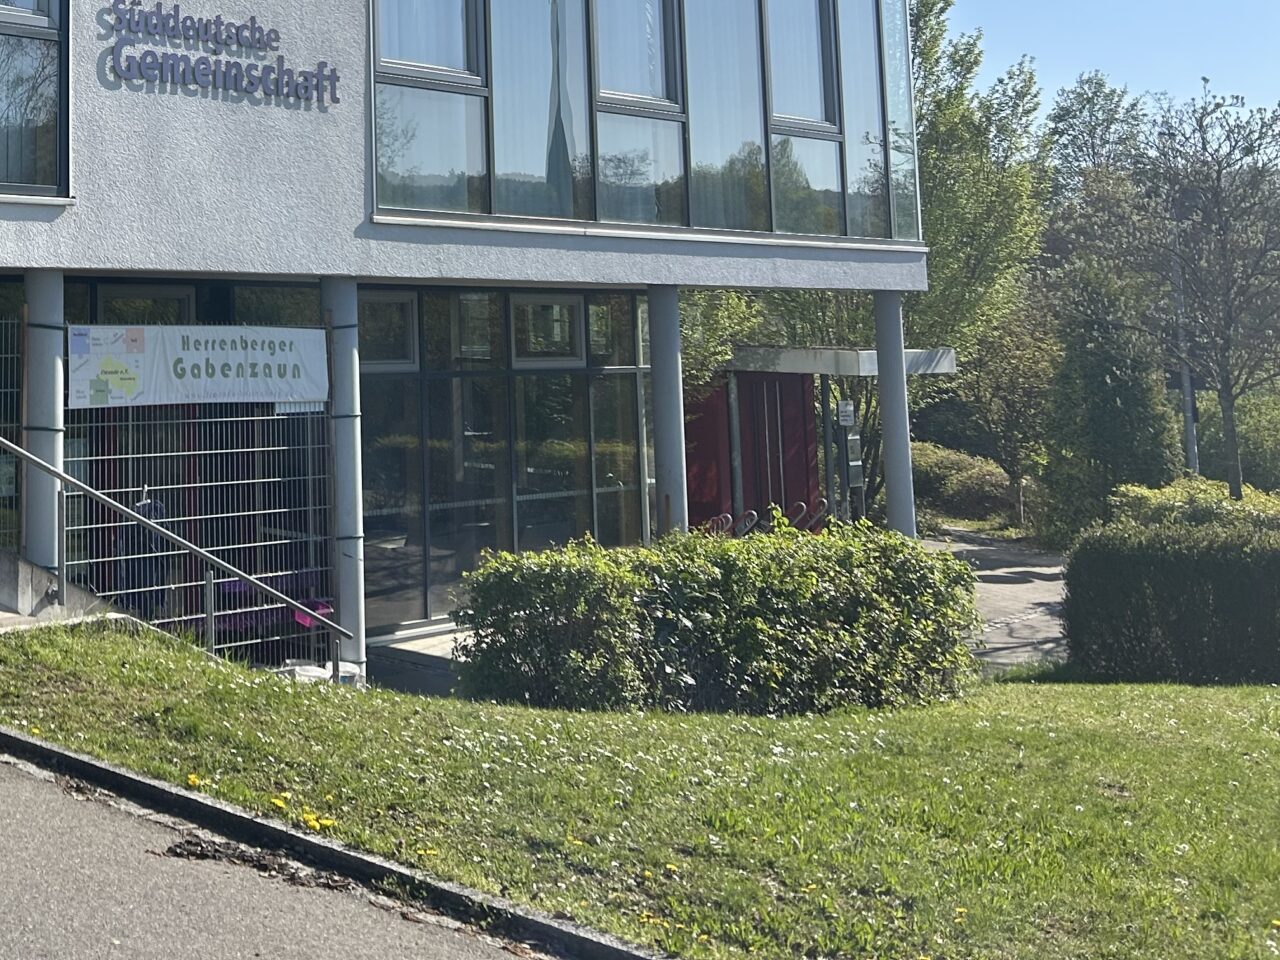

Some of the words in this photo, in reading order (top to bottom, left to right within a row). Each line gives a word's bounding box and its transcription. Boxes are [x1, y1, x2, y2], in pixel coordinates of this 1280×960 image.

[113, 41, 340, 104] Gemeinschaft
[181, 335, 294, 356] Herrenberger
[173, 358, 301, 380] Gabenzaun
